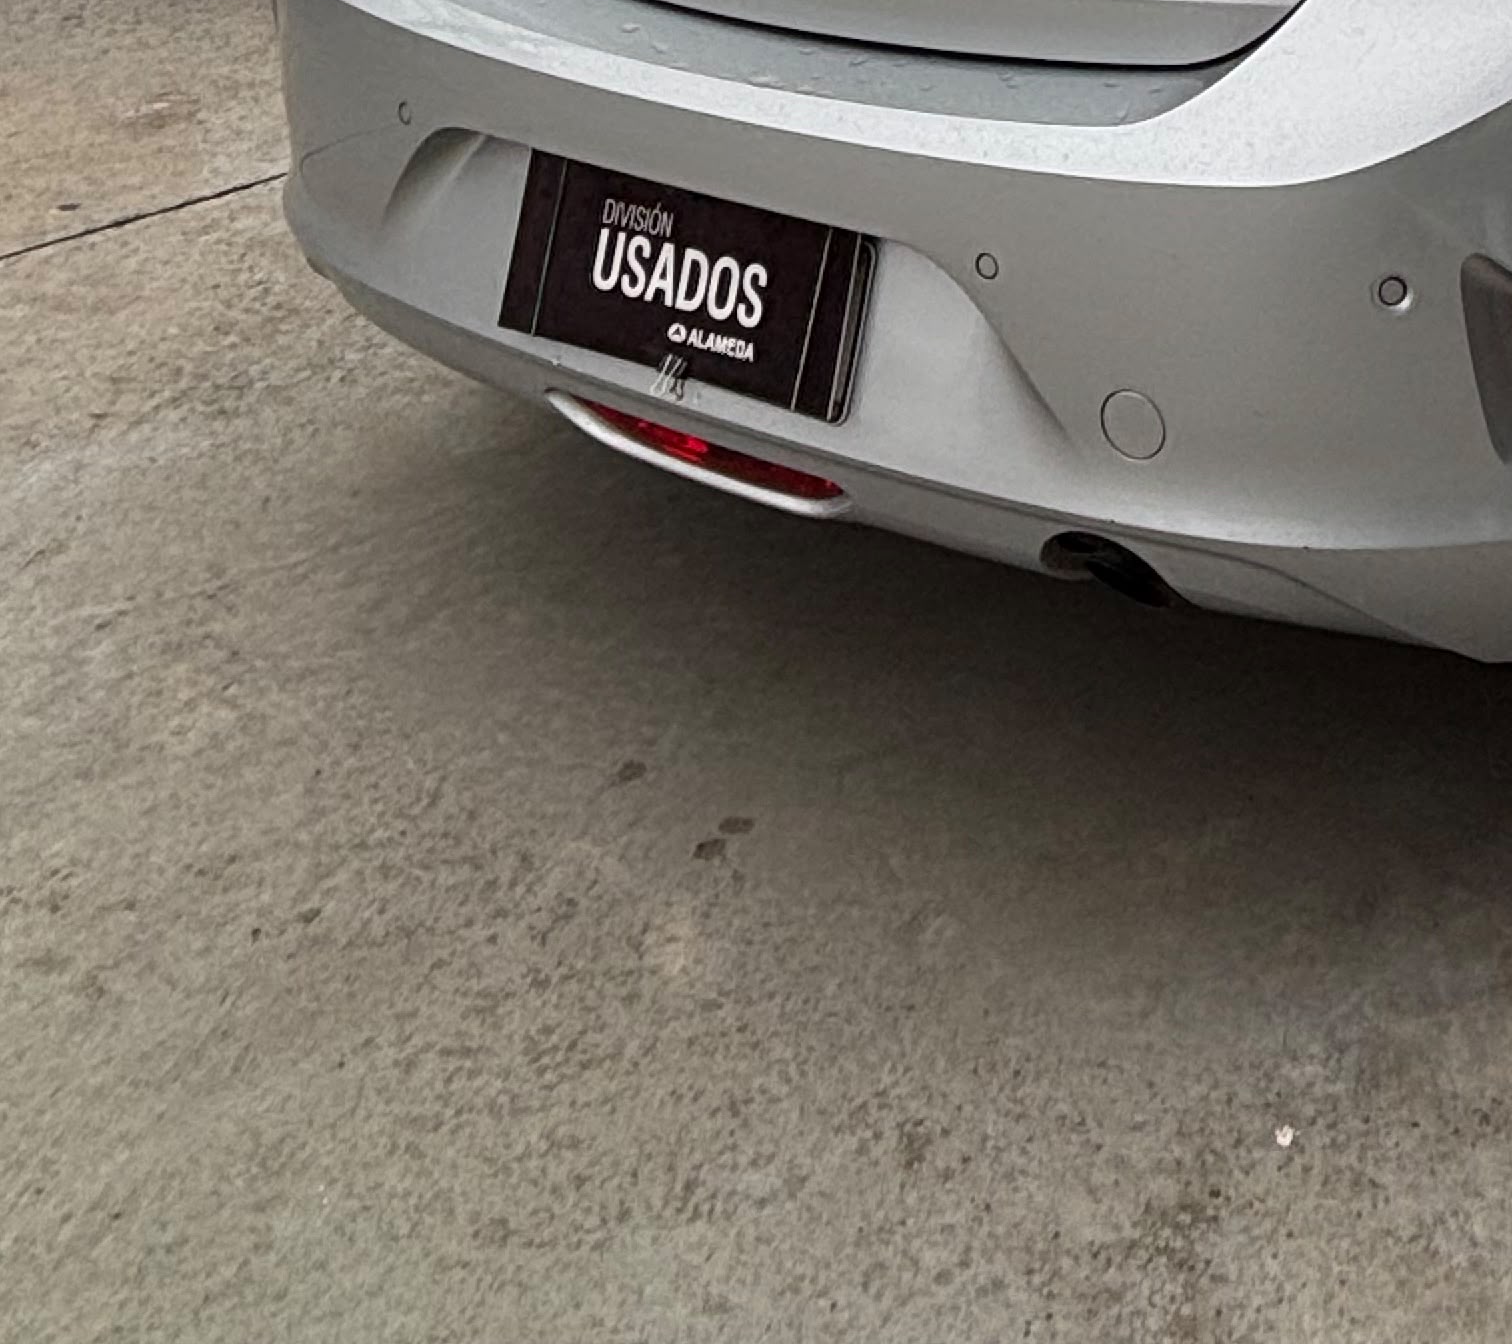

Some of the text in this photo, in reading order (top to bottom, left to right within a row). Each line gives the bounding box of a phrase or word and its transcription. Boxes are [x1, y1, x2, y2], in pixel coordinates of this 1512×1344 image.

[601, 197, 674, 239] DIVISIÓN
[592, 227, 768, 329] USADOS
[686, 327, 755, 363] ALAMEDA
